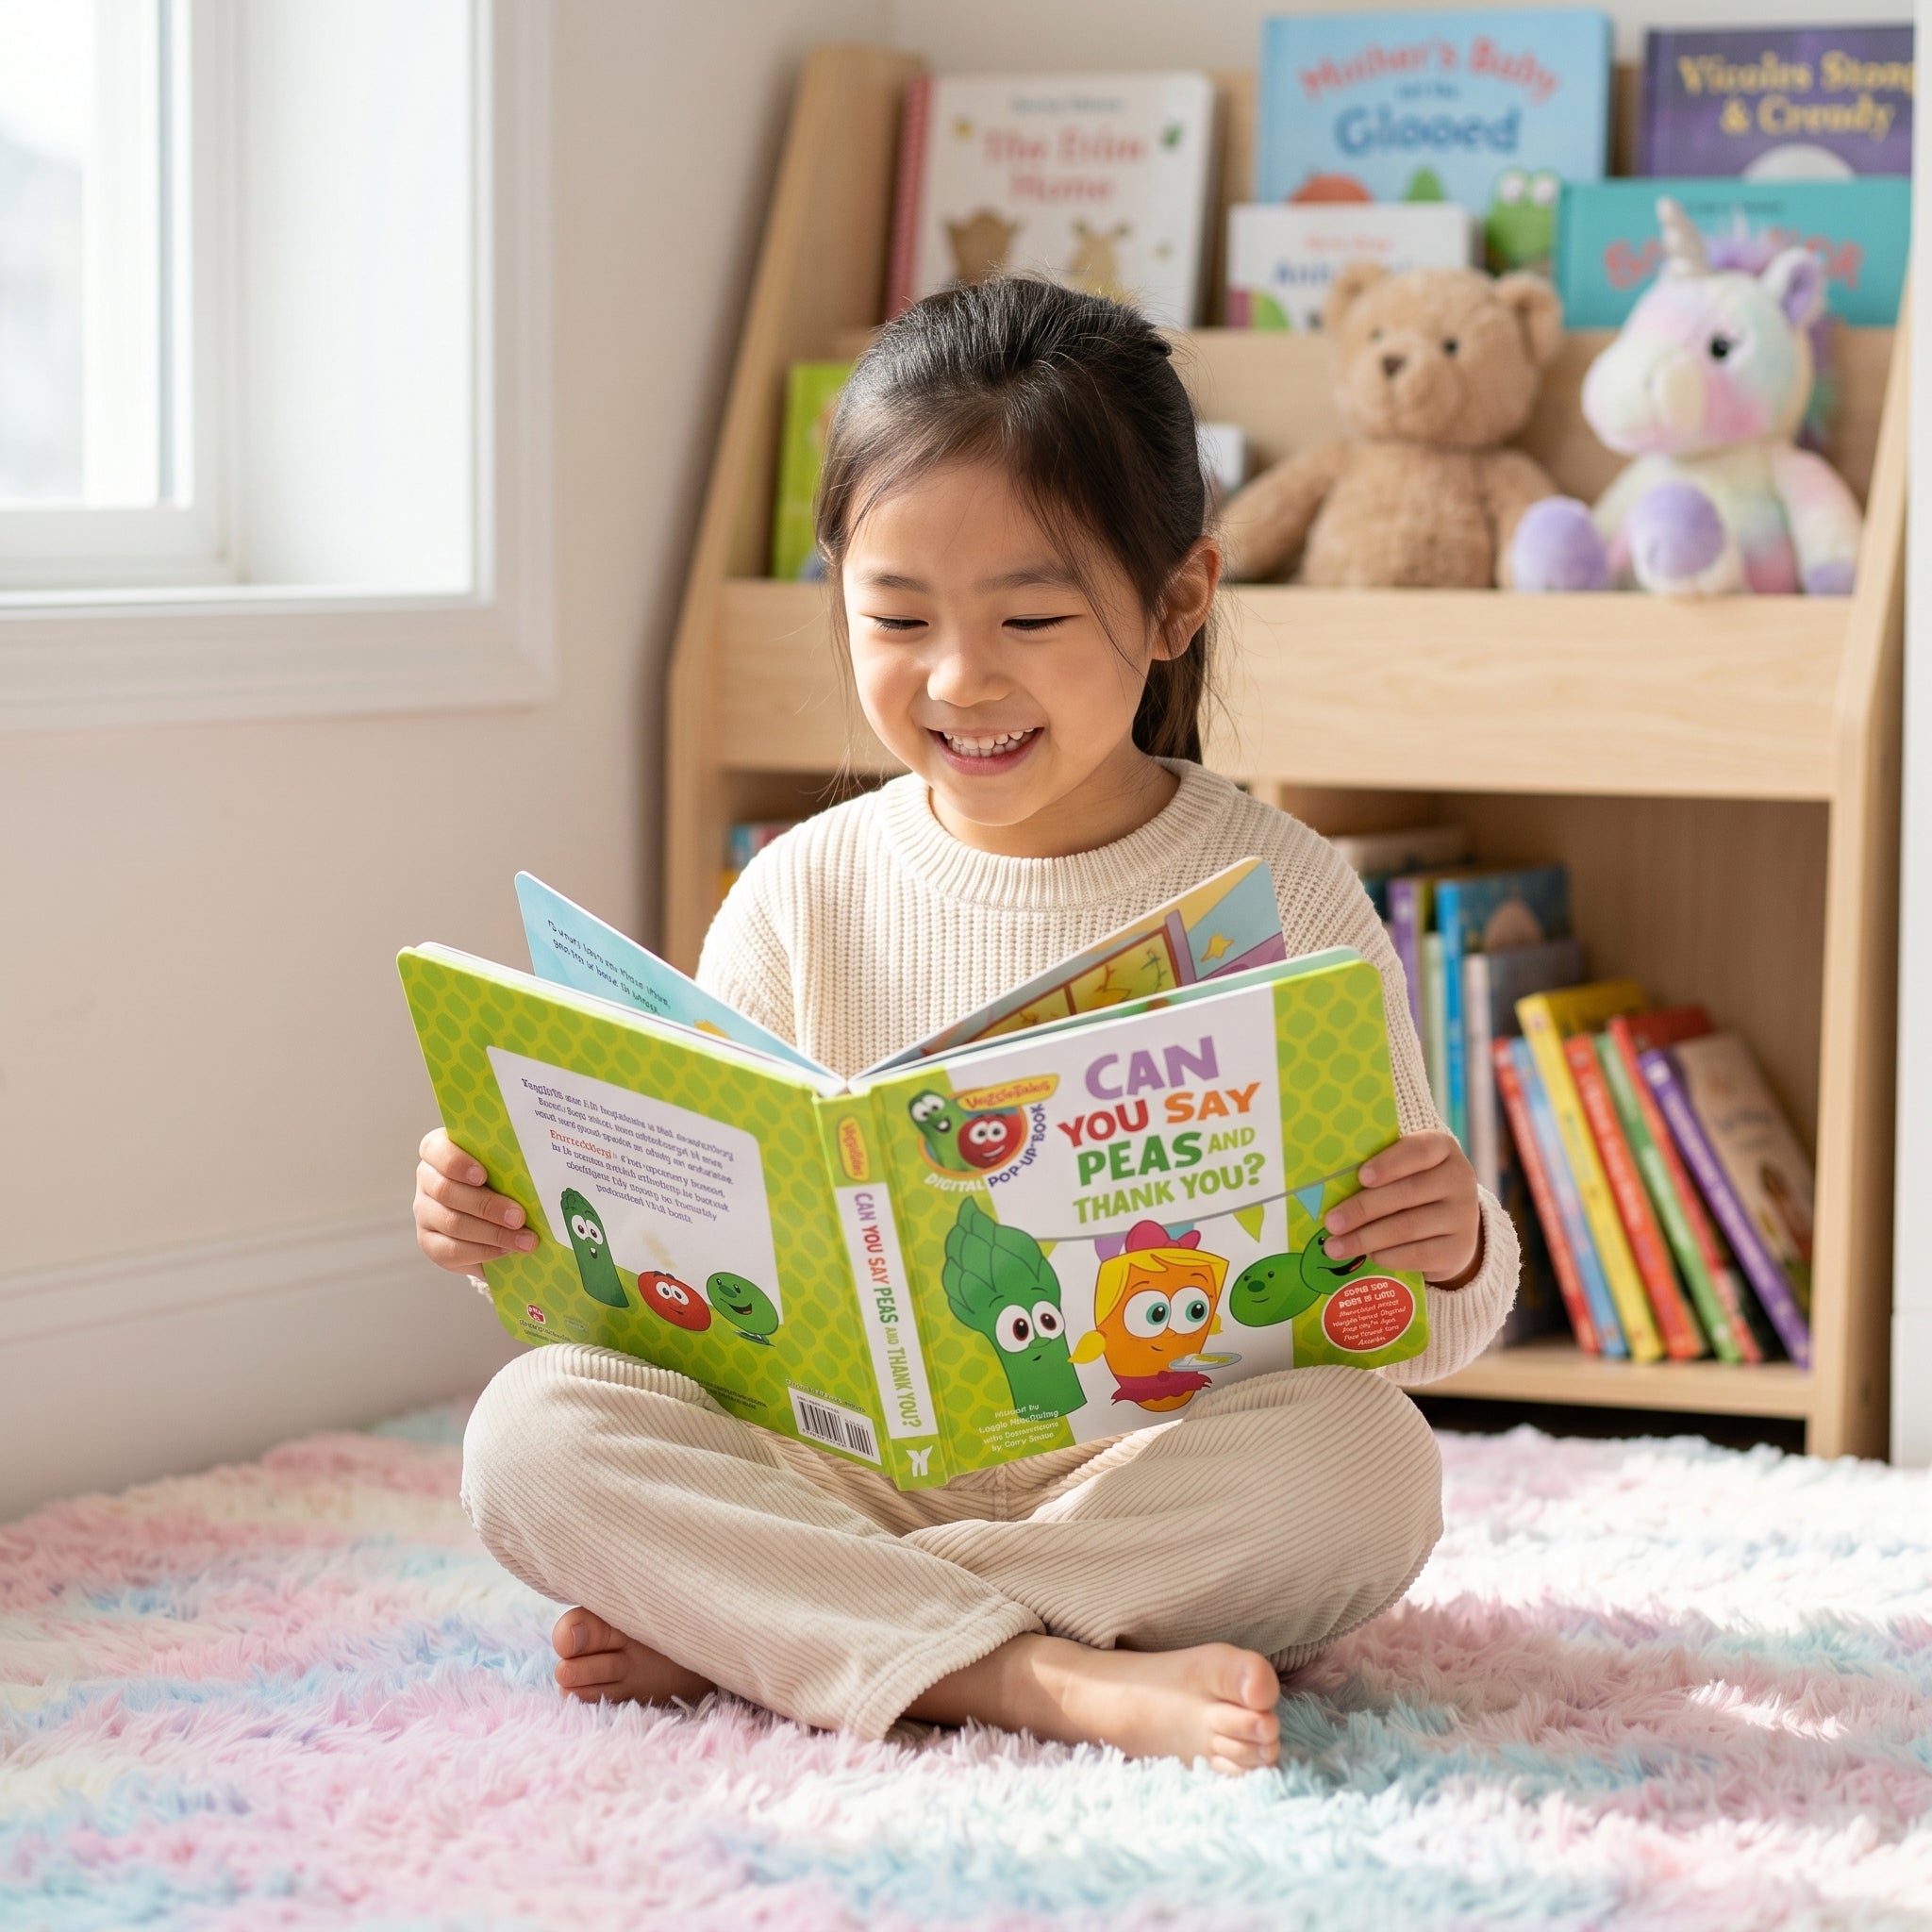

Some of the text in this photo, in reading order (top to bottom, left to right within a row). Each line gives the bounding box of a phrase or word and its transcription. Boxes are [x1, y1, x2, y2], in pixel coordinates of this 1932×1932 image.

[1719, 95, 1750, 136] &
[1086, 1035, 1220, 1100] CAN
[1057, 1081, 1262, 1148] YOU SAY
[924, 1173, 986, 1193] DIGITAL
[1073, 1152, 1266, 1224] THANK YOU?
[1077, 1126, 1256, 1187] PEAS AND
[854, 1192, 923, 1428] CAN YOU SAY PEAS AND THANK YOU?
